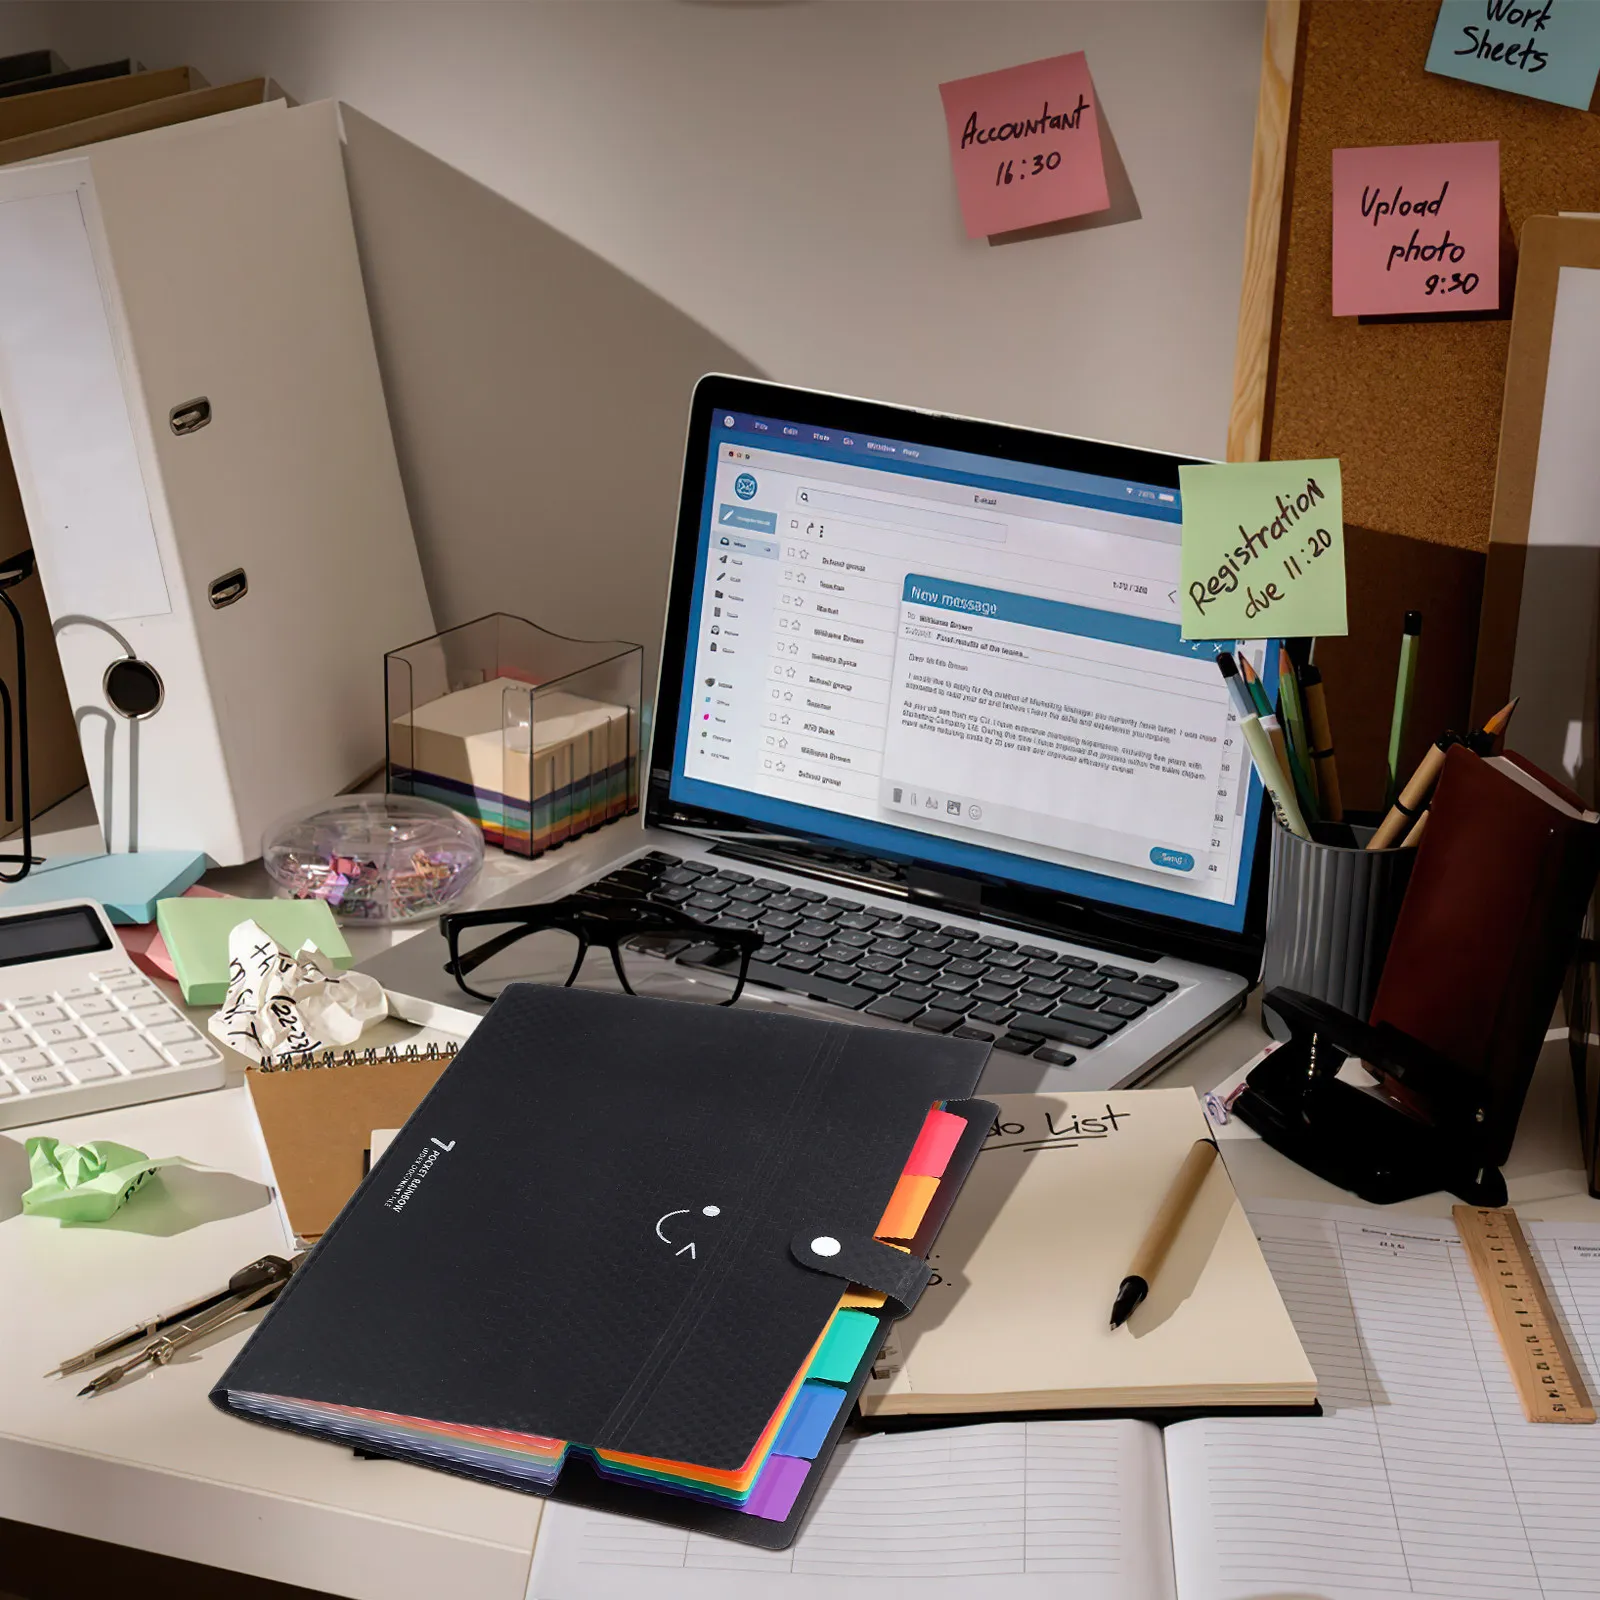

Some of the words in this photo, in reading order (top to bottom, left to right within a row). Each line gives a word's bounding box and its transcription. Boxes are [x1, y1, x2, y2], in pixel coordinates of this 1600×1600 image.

[1486, 0, 1552, 32] Work
[1454, 26, 1549, 73] Sheets
[960, 93, 1091, 150] Accountant
[996, 151, 1062, 187] 16:30
[1360, 180, 1450, 227] Upload
[1386, 228, 1466, 272] photo
[1189, 477, 1326, 616] Registration
[1283, 528, 1332, 581] 11:20
[1045, 1103, 1132, 1136] List
[416, 1149, 441, 1179] POCKET
[430, 1137, 457, 1152] 7
[392, 1178, 421, 1214] RAINBOW
